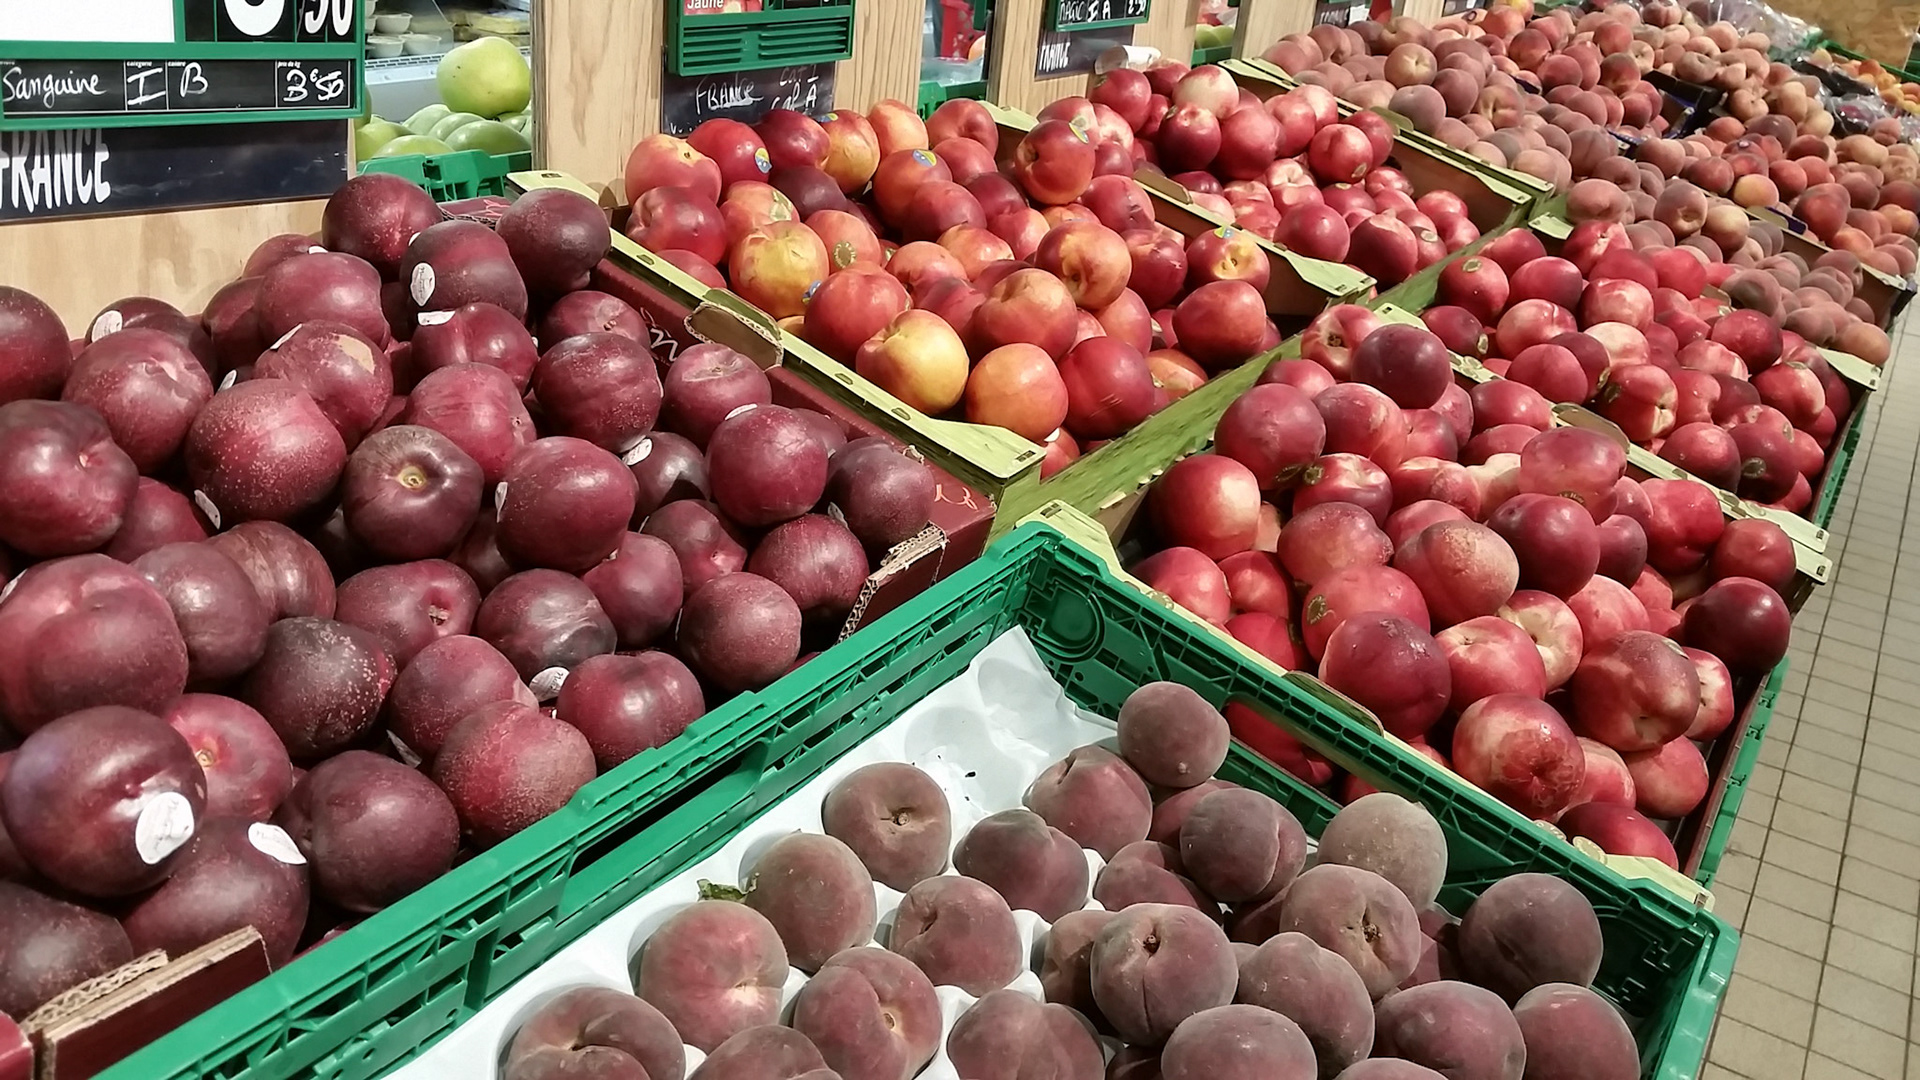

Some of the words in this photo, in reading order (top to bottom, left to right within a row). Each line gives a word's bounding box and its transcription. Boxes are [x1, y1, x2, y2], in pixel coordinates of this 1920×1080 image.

[1102, 0, 1111, 20] A
[2, 66, 108, 109] Sanguine
[179, 62, 209, 98] B
